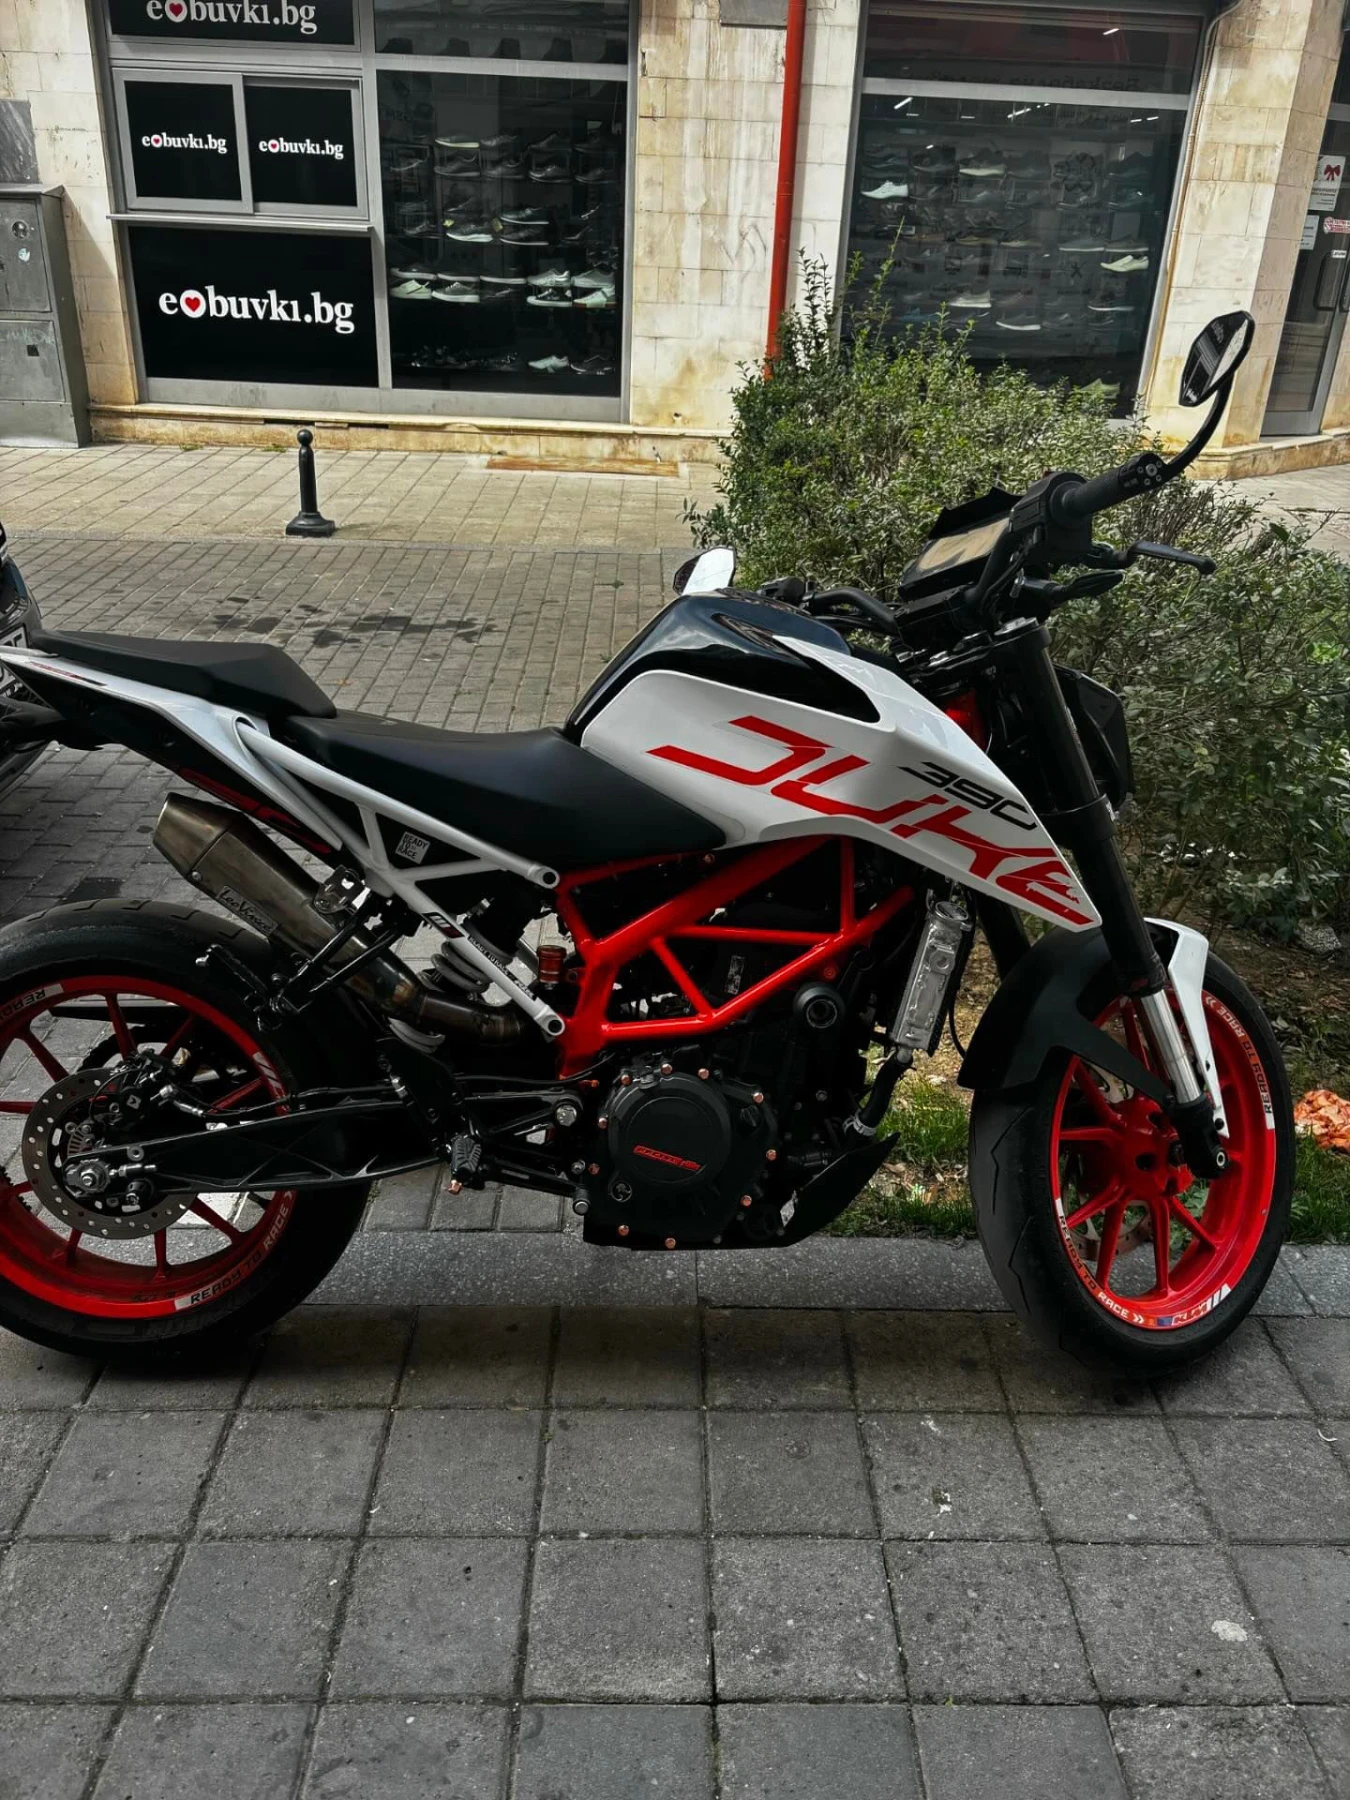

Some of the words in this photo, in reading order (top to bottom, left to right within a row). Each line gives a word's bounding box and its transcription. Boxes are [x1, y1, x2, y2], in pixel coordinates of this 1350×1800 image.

[141, 132, 228, 154] eobuvki.bg
[258, 137, 344, 160] eobuvki.bg
[158, 285, 355, 334] eobuvki.bg
[899, 761, 1038, 831] 390
[397, 845, 418, 859] RACE
[404, 833, 429, 849] READY
[1216, 1007, 1246, 1038] RACE
[1252, 1063, 1273, 1114] READY
[190, 1269, 241, 1304] READY
[263, 1205, 290, 1251] RACE
[1097, 1290, 1130, 1320] RACE
